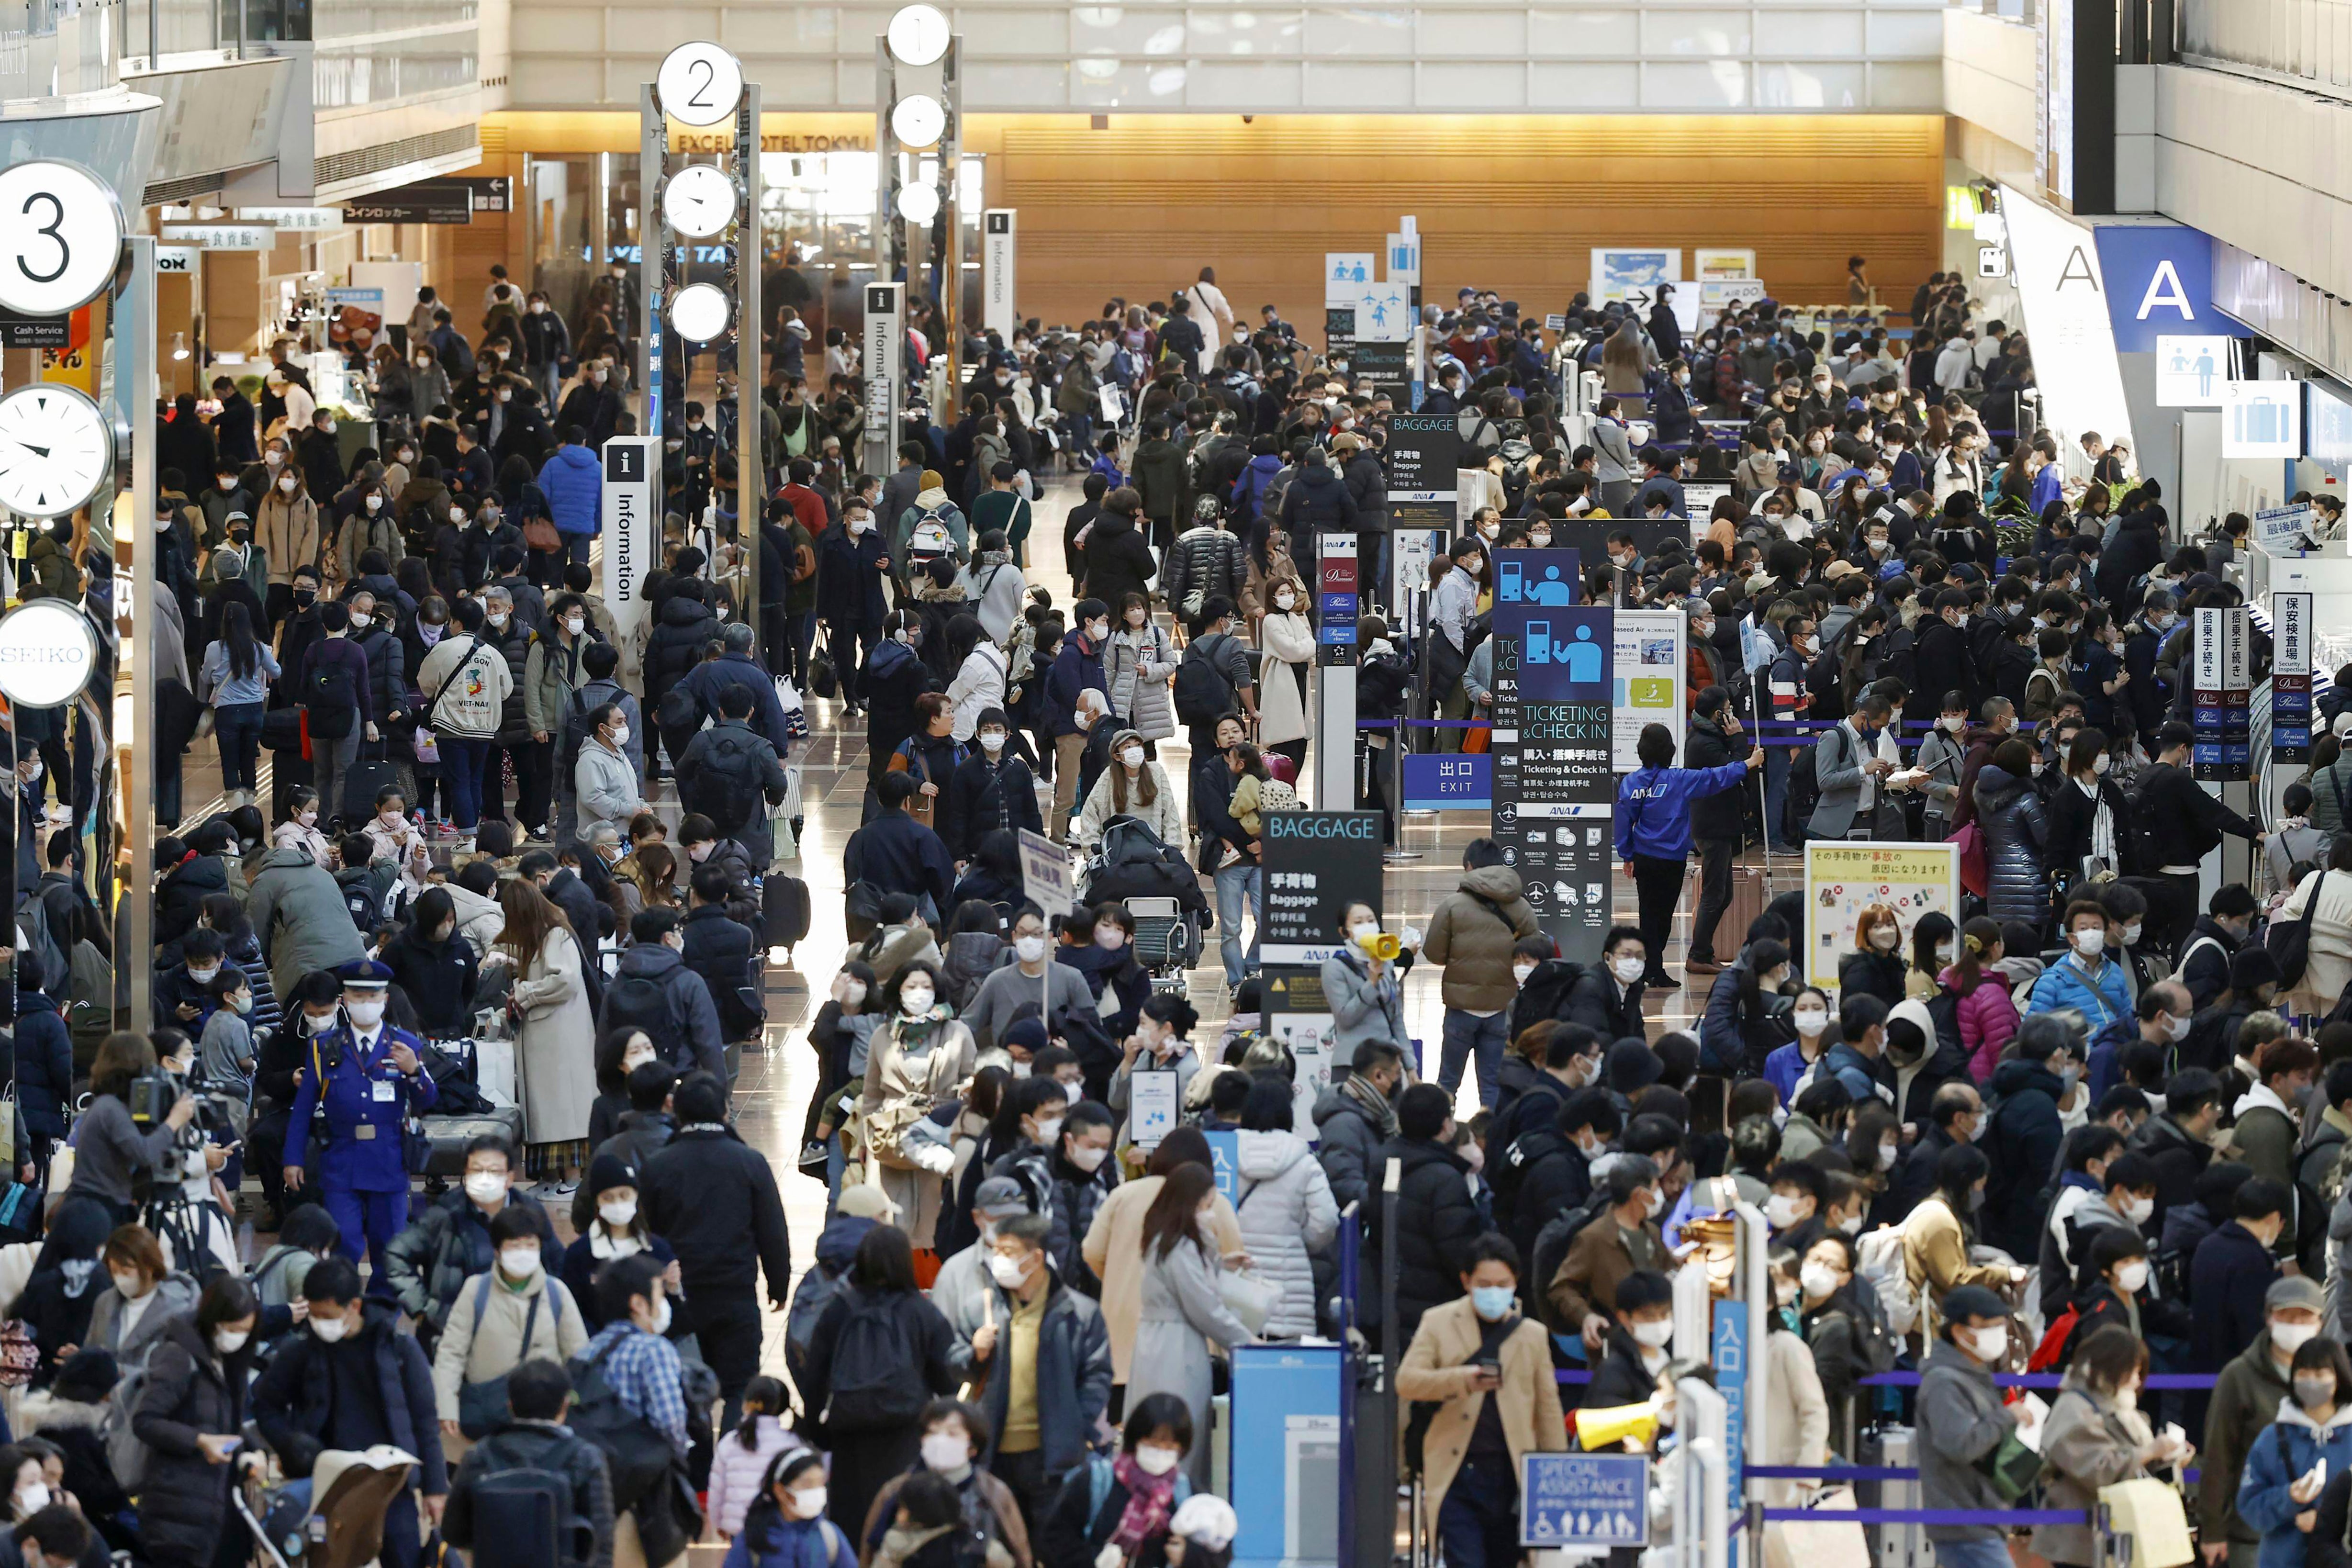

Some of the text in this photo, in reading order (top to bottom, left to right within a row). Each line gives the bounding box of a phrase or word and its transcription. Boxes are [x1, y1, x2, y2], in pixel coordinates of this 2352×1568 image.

[688, 59, 714, 108] 2
[678, 134, 734, 150] EXCEL
[803, 135, 869, 152] TOKYU
[16, 191, 70, 283] 3
[994, 240, 1002, 303] Information
[2055, 245, 2099, 292] A
[1742, 287, 1758, 296] DO
[2136, 260, 2195, 320] A
[14, 326, 64, 335] Cash Service
[875, 322, 886, 378] Informat
[2230, 383, 2238, 397] 5
[1394, 418, 1454, 431] BAGGAGE
[1393, 450, 1421, 459] 手荷物
[2267, 519, 2303, 536] 最後尾
[618, 494, 635, 601] Information
[2285, 597, 2298, 660] 保安検査場
[2203, 611, 2213, 677] 搭乗手続き
[2231, 611, 2241, 677] 搭乗手続き
[1, 647, 83, 663] SEIKO
[1141, 651, 1152, 661] T2
[1523, 706, 1607, 721] TICKETING
[1523, 723, 1587, 739] &CHECK
[1591, 724, 1606, 739] IN
[2280, 729, 2306, 739] Premium
[1523, 749, 1608, 761] 購入・搭乗手続き
[2200, 745, 2219, 756] Premium
[1440, 761, 1463, 776] 出口
[1523, 765, 1608, 775] Ticketing & Check In
[1441, 783, 1463, 792] EXIT
[1630, 787, 1652, 800] ANA
[1549, 807, 1570, 815] ANA
[1270, 817, 1375, 839] BAGGAGE
[1814, 851, 1902, 862] その手荷物が事故の
[1870, 863, 1945, 874] 原因になります！
[1270, 873, 1317, 889] 手荷物
[1269, 894, 1319, 907] Baggage
[1303, 950, 1329, 960] ANA
[1212, 1146, 1232, 1193] 入口
[1718, 1318, 1741, 1372] 入口
